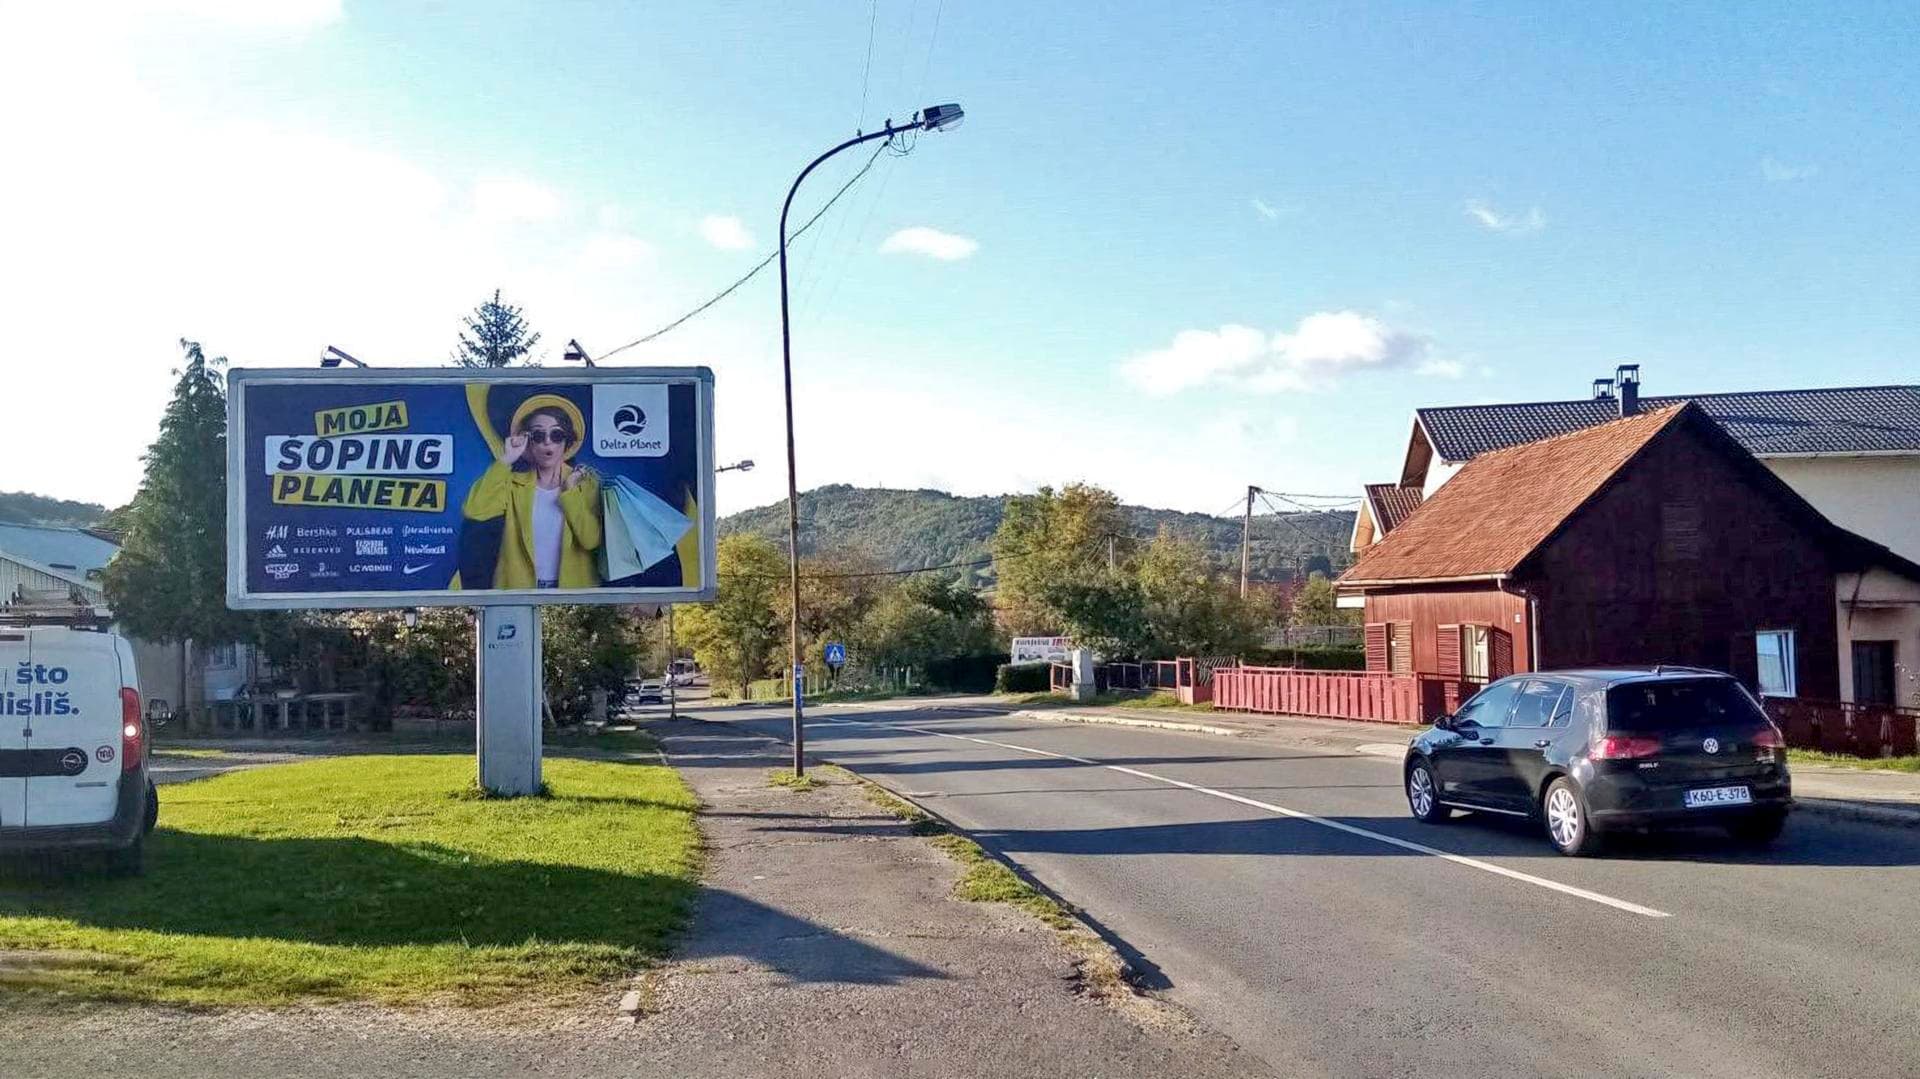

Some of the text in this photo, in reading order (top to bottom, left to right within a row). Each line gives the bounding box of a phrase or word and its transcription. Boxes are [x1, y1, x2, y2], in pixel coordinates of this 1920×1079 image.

[323, 404, 403, 434] MOJA
[277, 434, 442, 471] ŠOPING
[600, 439, 661, 450] Delta Planet
[279, 475, 438, 508] PLANETA
[297, 527, 337, 537] Bershka
[16, 662, 68, 684] što
